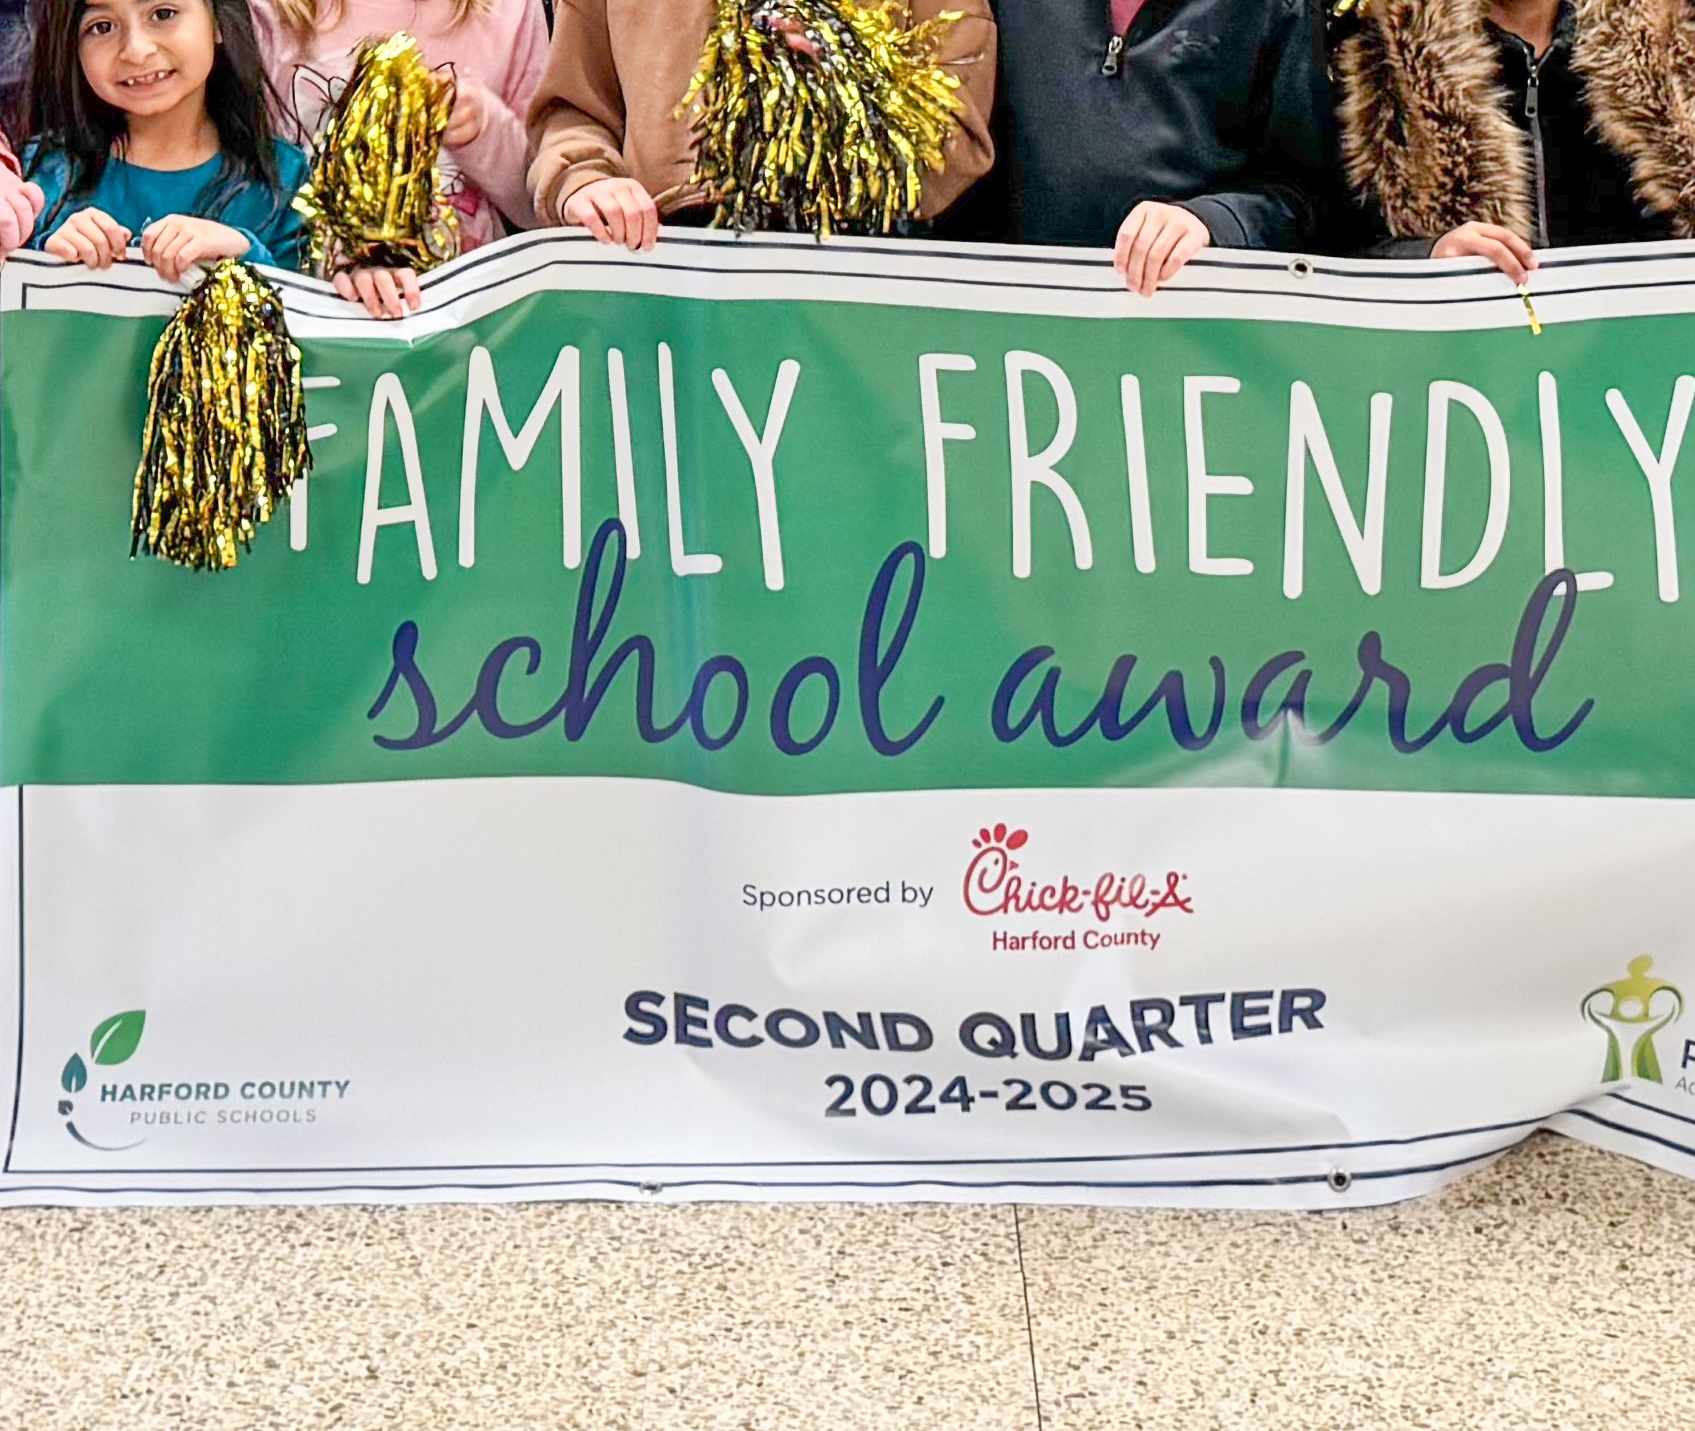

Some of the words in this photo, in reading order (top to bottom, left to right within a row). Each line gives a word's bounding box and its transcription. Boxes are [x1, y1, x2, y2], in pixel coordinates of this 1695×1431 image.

[289, 340, 802, 590] FAMILY
[365, 515, 948, 757] school
[989, 566, 1597, 756] award
[741, 880, 890, 911] Sponsored
[900, 880, 935, 910] by
[963, 842, 1194, 923] Chick-fil-A
[992, 930, 1075, 951] Harford
[1083, 929, 1161, 951] County
[622, 990, 935, 1053] SECOND
[958, 987, 1328, 1063] QUARTER
[100, 1081, 229, 1102] HARFORD
[239, 1079, 351, 1101] COUNTY
[824, 1073, 1153, 1118] 2024-2025
[130, 1110, 206, 1125] PUBLIC
[217, 1108, 317, 1124] SCHOOLS
